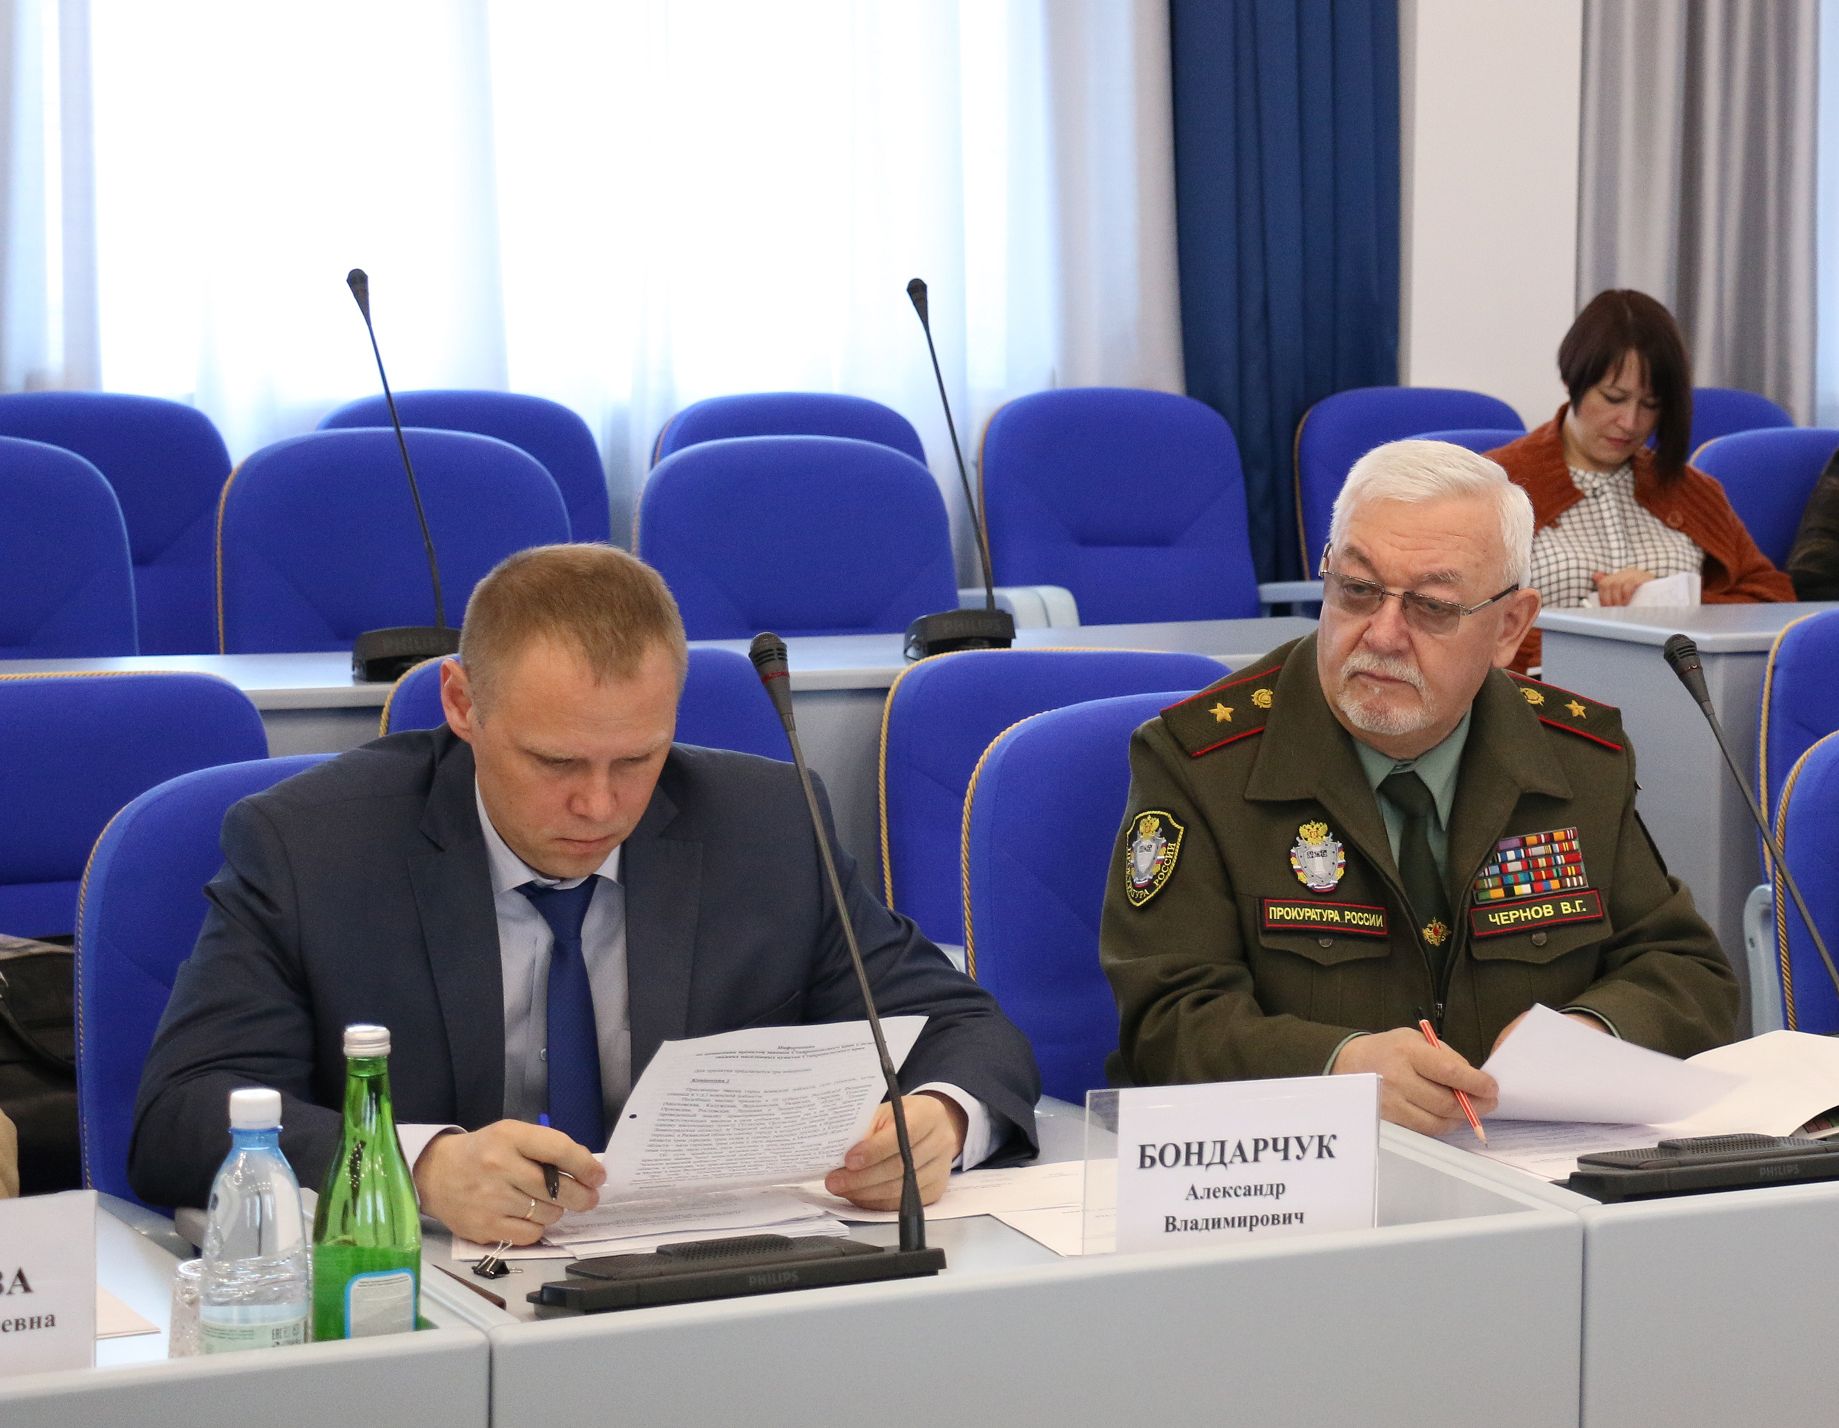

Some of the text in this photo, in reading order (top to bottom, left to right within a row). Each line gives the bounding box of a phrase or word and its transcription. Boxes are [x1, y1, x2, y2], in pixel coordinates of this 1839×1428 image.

[1268, 906, 1384, 928] ПРОКУРАТУРА РОССИИ
[1488, 900, 1587, 926] ЧЕРНОВ В.Г.
[1137, 1133, 1337, 1172] БОНДАРЧУК
[1185, 1182, 1287, 1202] Александр
[1163, 1211, 1305, 1233] Владимирович
[0, 1266, 34, 1295] А
[1, 1313, 56, 1333] евна
